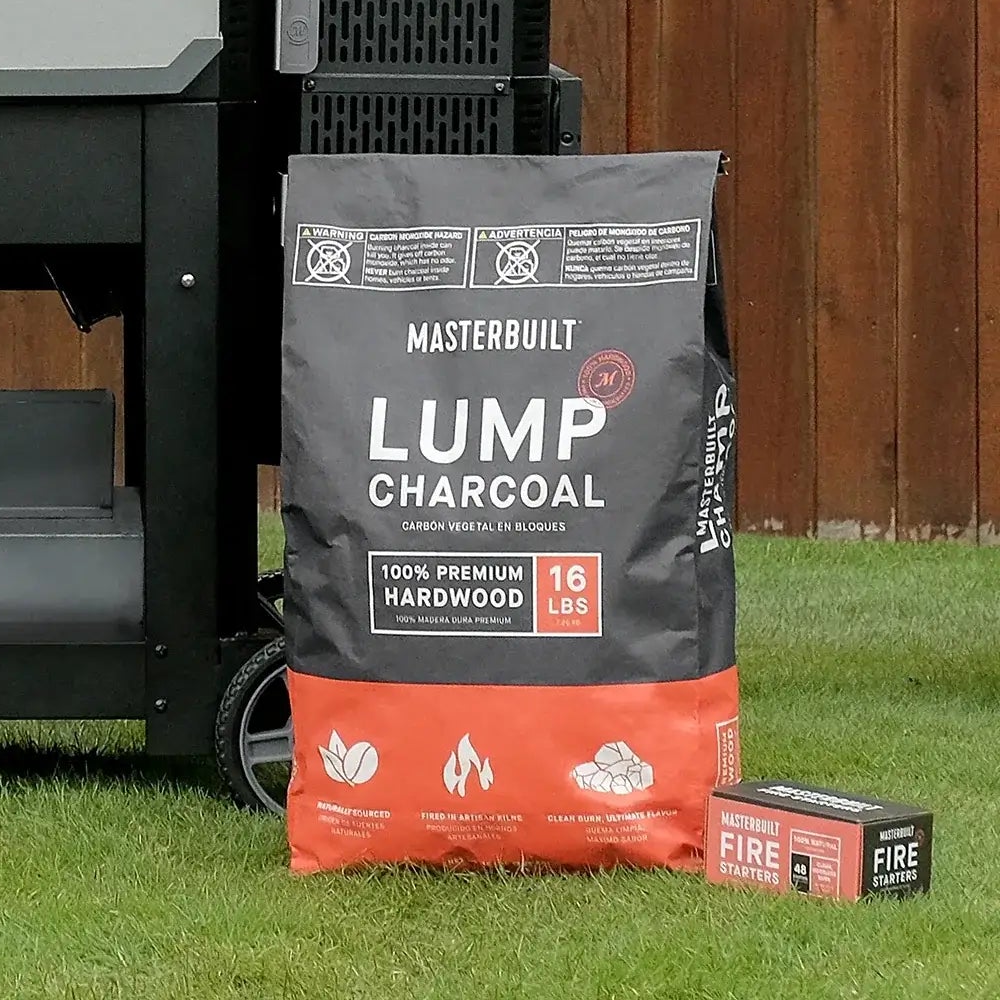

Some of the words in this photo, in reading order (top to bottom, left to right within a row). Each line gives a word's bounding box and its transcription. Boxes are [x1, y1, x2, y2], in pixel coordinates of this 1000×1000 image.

[313, 228, 364, 240] WARNING
[489, 228, 562, 238] ADVERTENCIA
[407, 319, 577, 353] MASTERBUILT
[368, 396, 607, 465] LUMP
[696, 415, 716, 536] MASTERBUILT
[368, 474, 605, 509] CHARCOAL
[448, 521, 494, 532] VEGETAL
[498, 521, 511, 531] EN
[515, 521, 566, 532] BLOQUES
[381, 564, 430, 581] 100%
[437, 565, 523, 581] PREMIUM
[550, 565, 587, 592] 16
[384, 587, 524, 608] HARDWOOD
[548, 597, 589, 615] LBS
[396, 615, 416, 624] 100%
[418, 615, 450, 624] MADERA
[475, 617, 511, 625] PREMIUM
[352, 808, 391, 818] SOURCED
[421, 812, 445, 821] FIRED
[721, 811, 780, 836] MASTERBUILT
[880, 825, 914, 841] MASTERBUILT
[720, 831, 779, 869] FIRE
[874, 842, 919, 874] FIRE
[720, 861, 779, 885] STARTERS
[794, 863, 807, 875] 48
[873, 869, 917, 887] STARTERS
